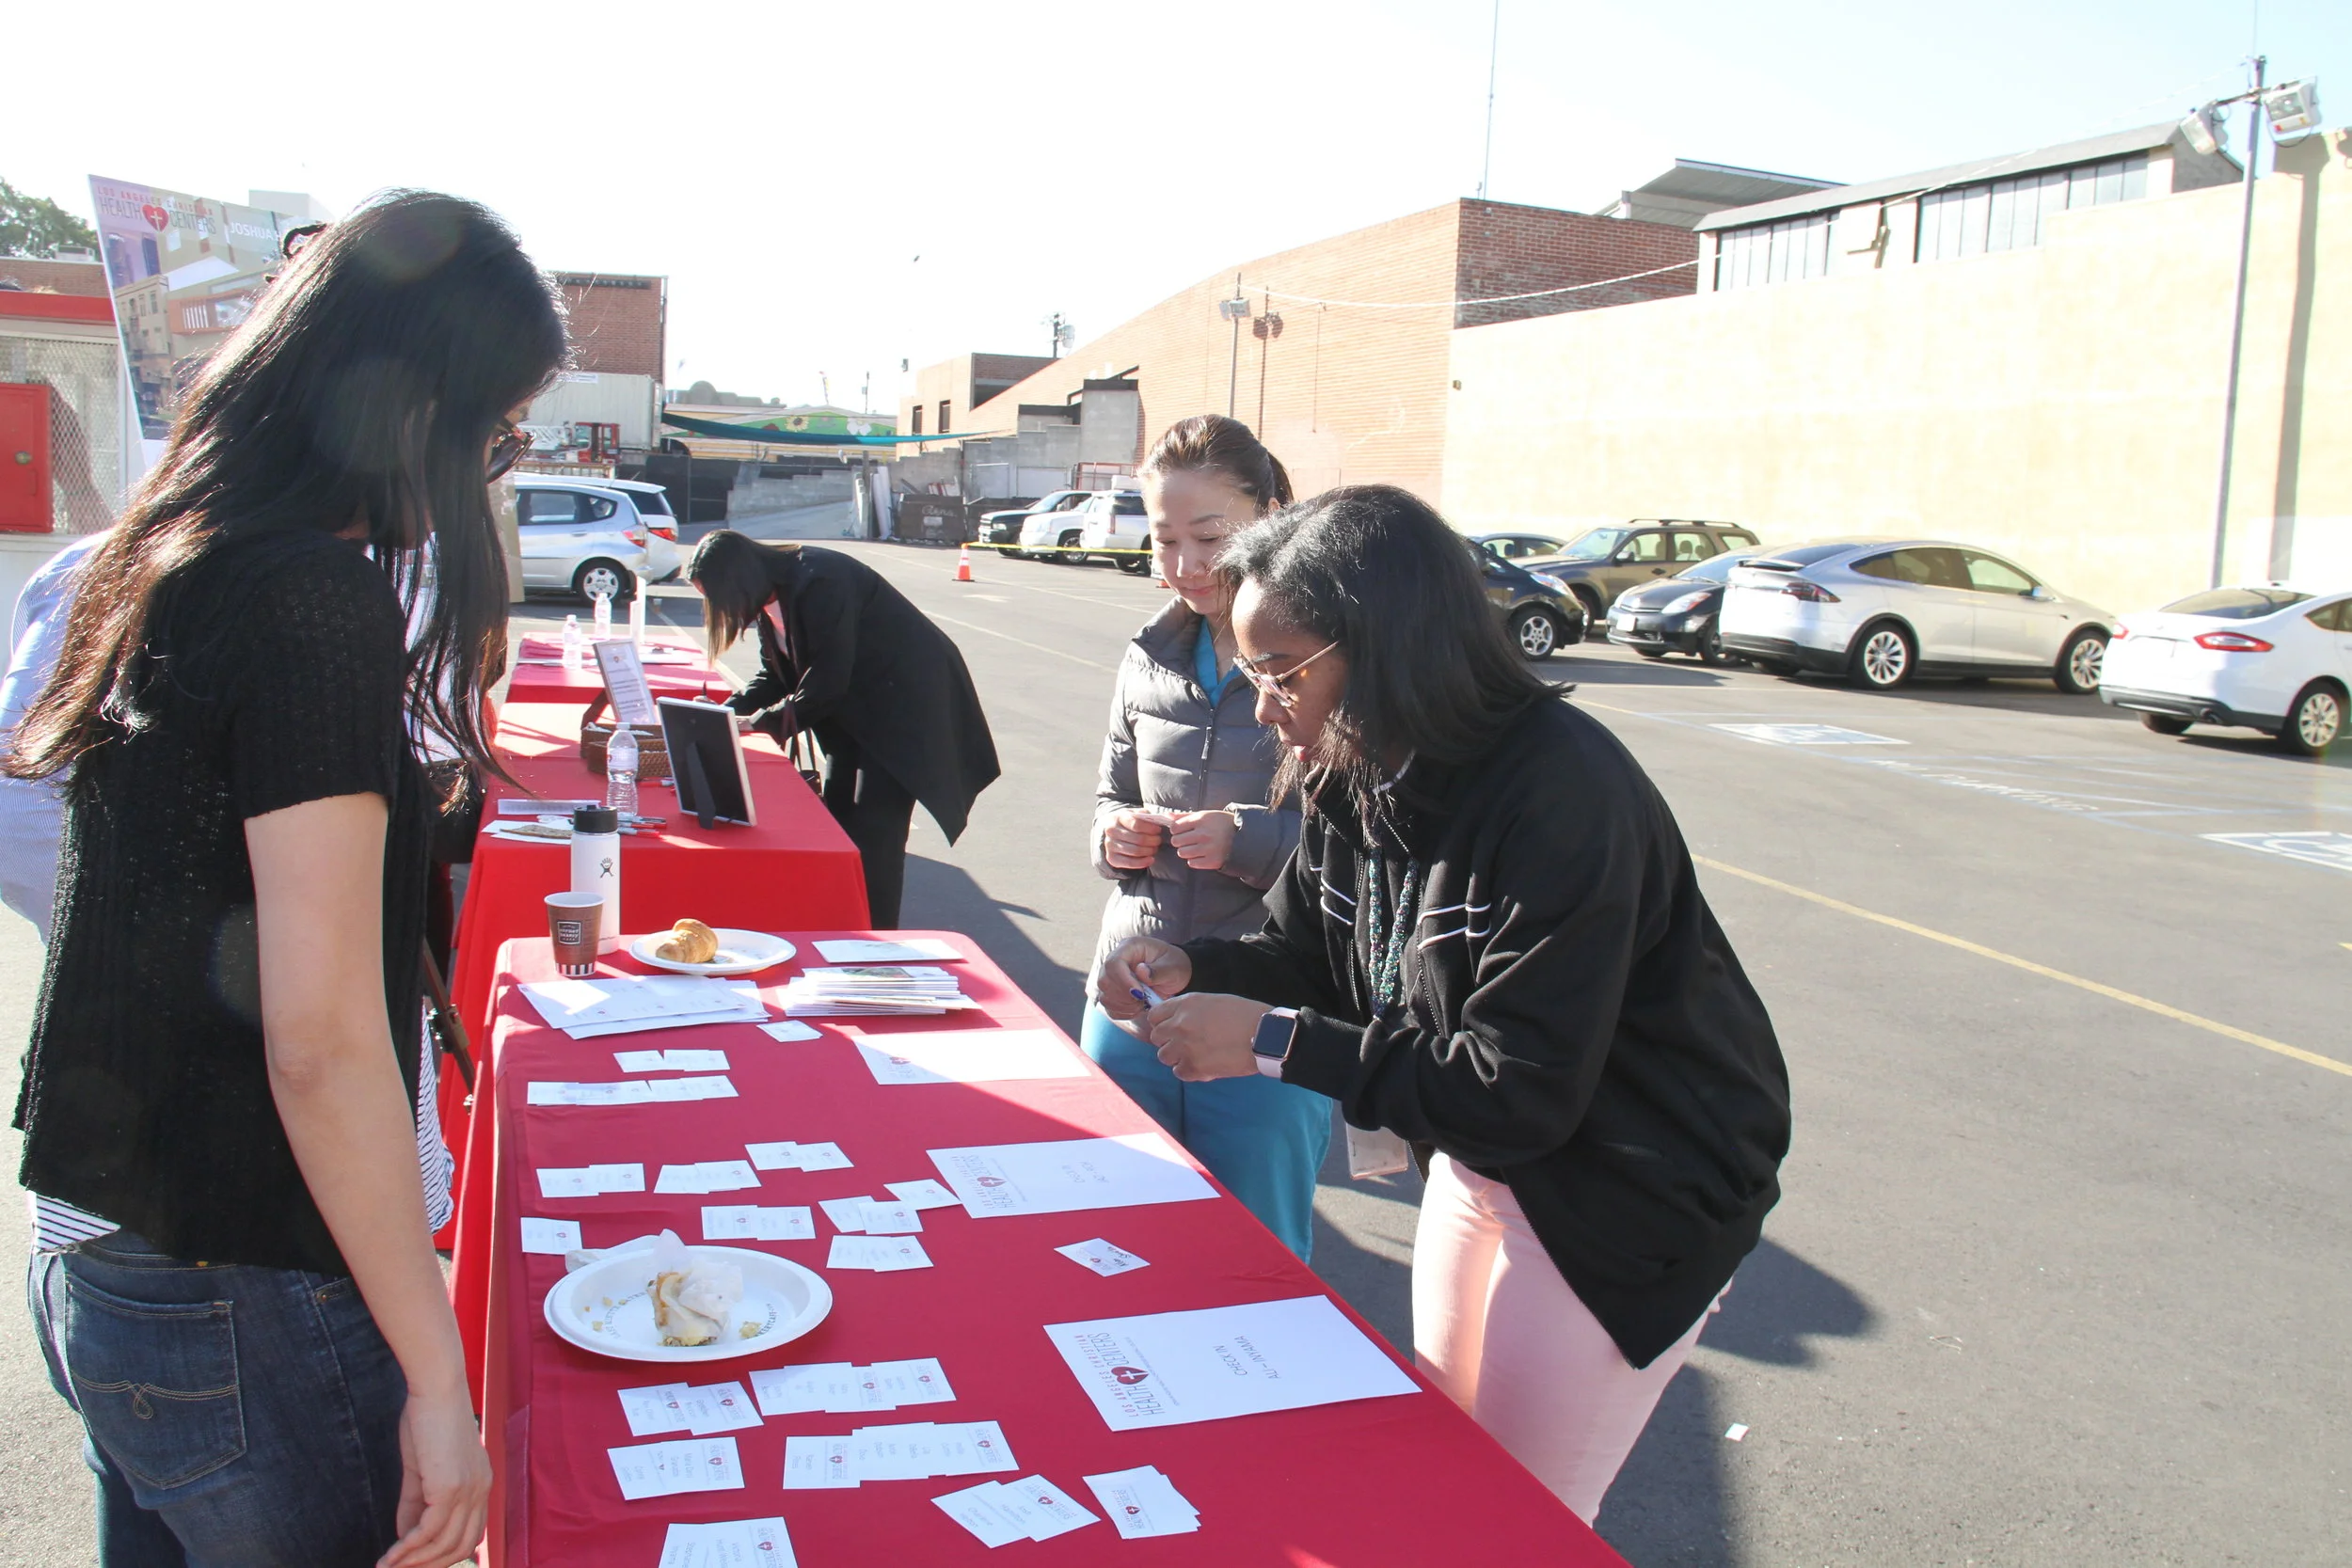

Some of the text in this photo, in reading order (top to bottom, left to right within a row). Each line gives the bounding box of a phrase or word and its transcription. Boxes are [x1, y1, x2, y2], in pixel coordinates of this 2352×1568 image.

[100, 196, 216, 235] HEALTH CENTERS
[230, 222, 274, 241] JOSHUA
[1088, 1332, 1130, 1367] CENTERS
[1221, 1353, 1248, 1377] CHECK
[1233, 1335, 1266, 1363] INYAMA
[1074, 1334, 1138, 1418] LOS ANGELES CHRISTIAN
[1127, 1385, 1166, 1417] HEALTH
